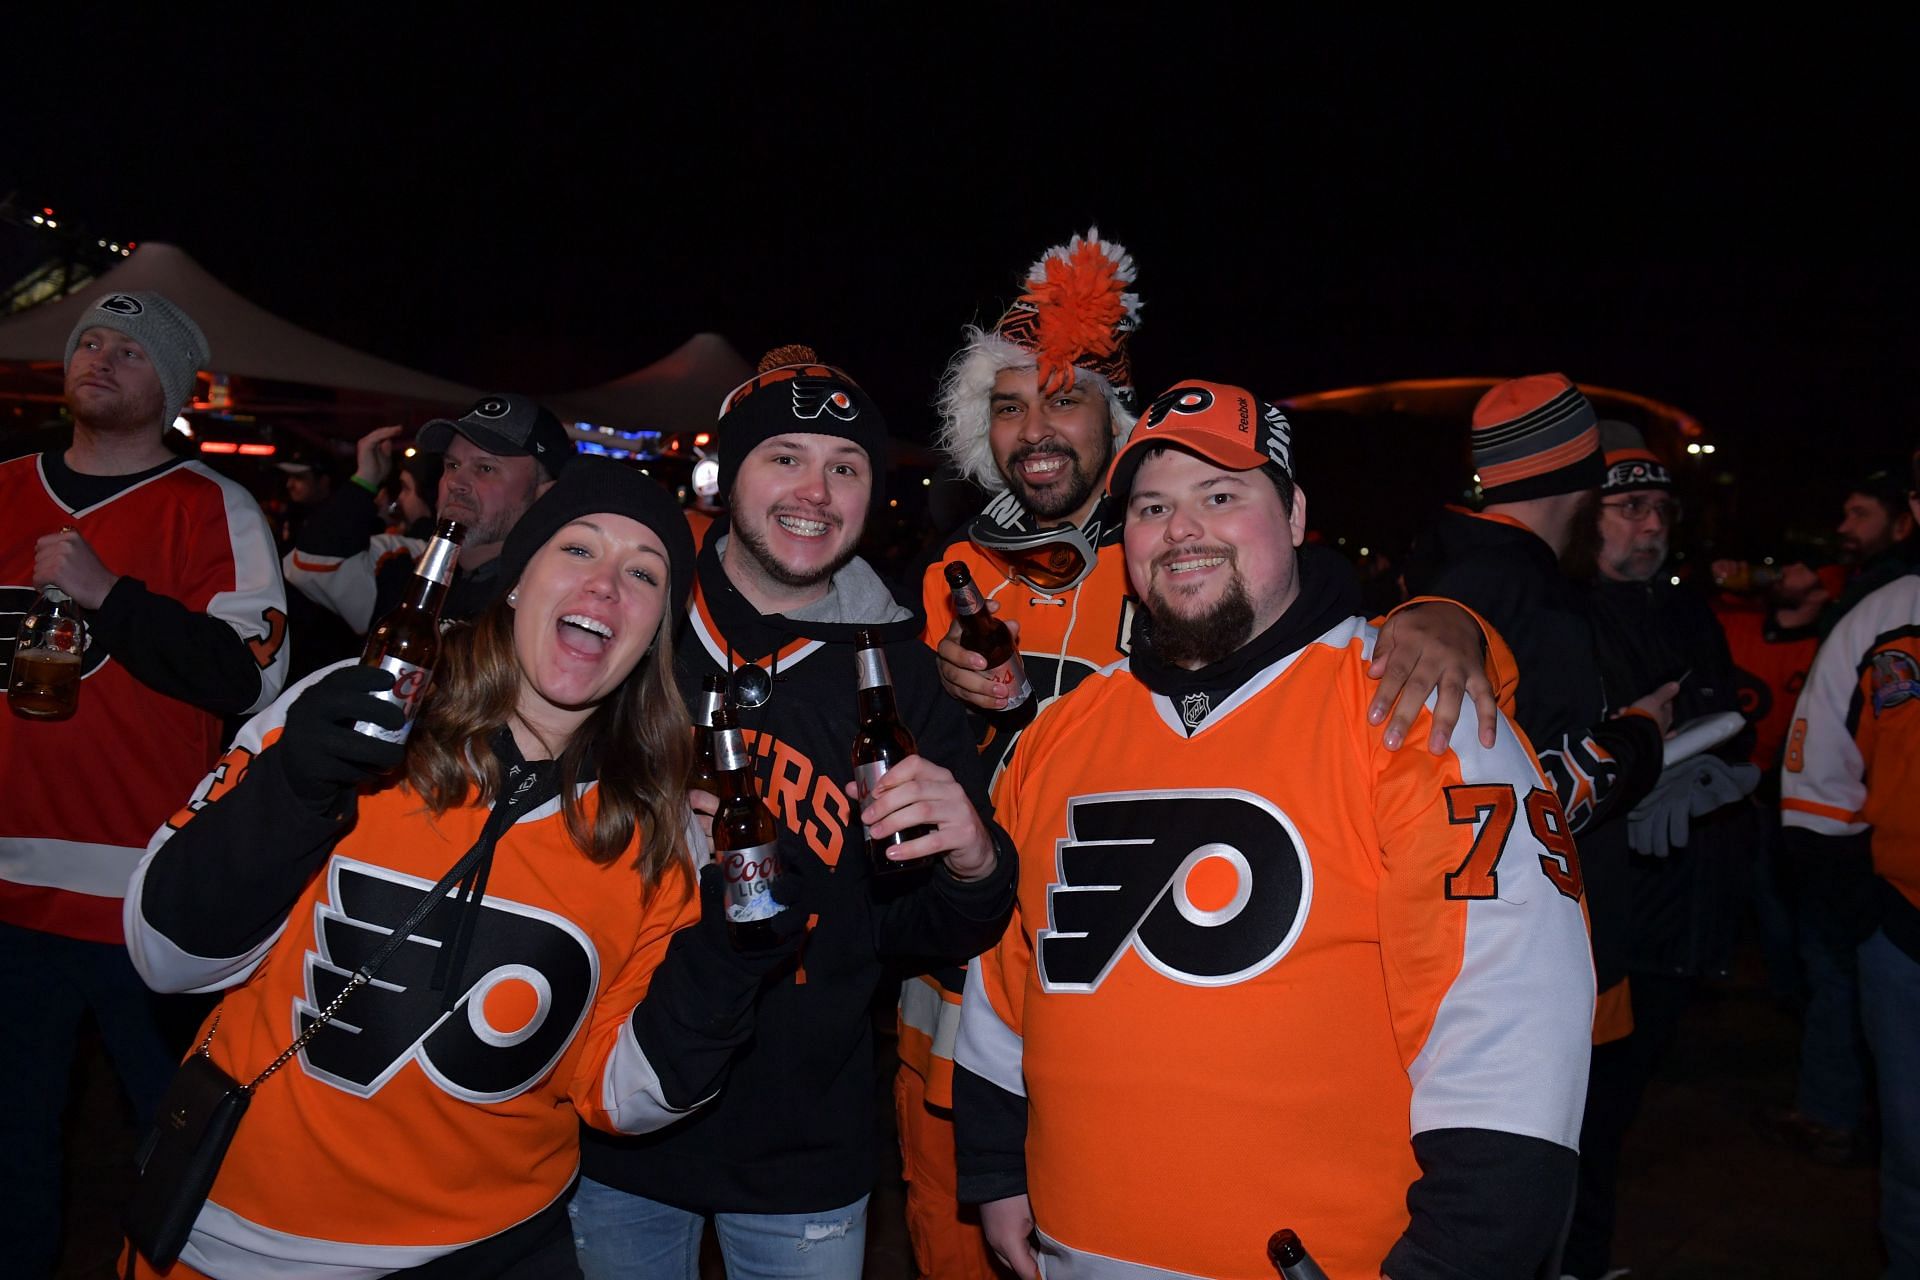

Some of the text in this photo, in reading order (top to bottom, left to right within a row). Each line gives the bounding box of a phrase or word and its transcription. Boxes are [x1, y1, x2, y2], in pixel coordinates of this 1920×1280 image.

[1238, 397, 1249, 433] Reebok
[1187, 701, 1206, 722] NHL
[1442, 784, 1583, 903] 79
